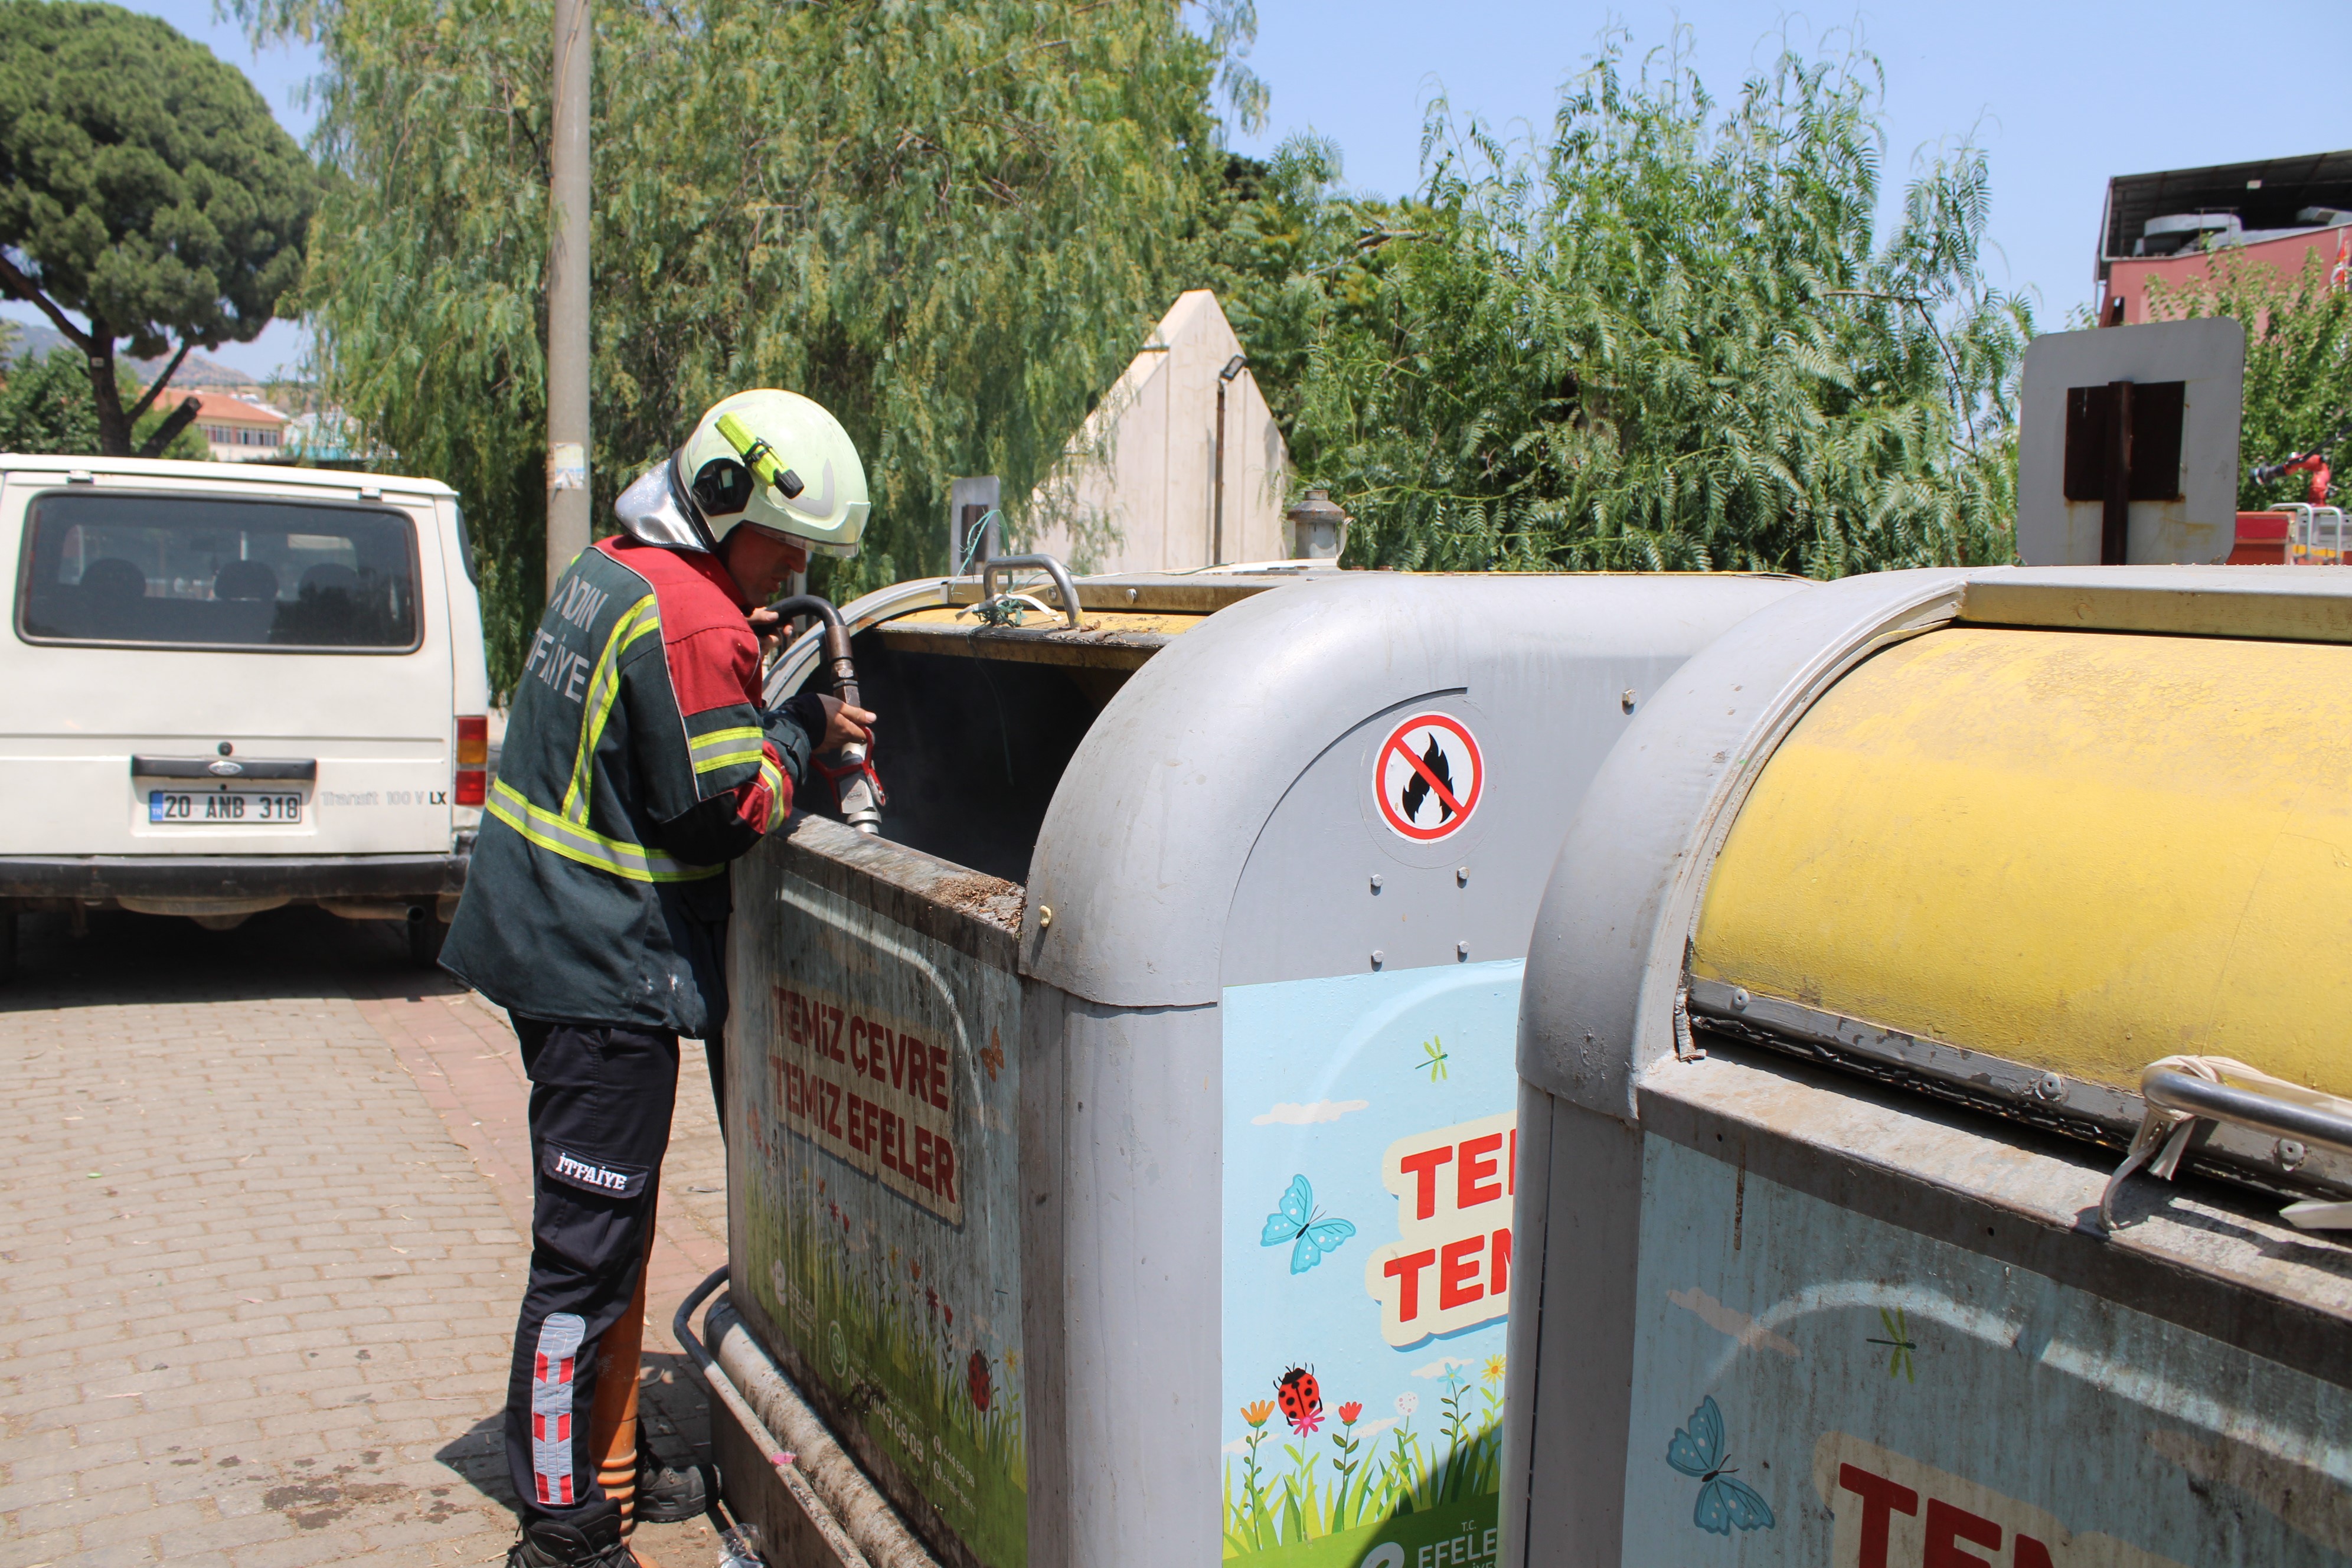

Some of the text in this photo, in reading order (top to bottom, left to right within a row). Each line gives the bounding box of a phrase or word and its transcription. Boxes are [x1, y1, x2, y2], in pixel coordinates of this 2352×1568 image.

[165, 795, 298, 819] 20 ANB 318
[321, 790, 447, 806] Transit 100 V LX
[772, 985, 948, 1112] TEMİZ ÇEVRE
[769, 1055, 956, 1204] TEMİZ EFELER
[556, 1152, 628, 1190] İTFAİYE
[1400, 1128, 1517, 1220] TE
[1461, 1520, 1477, 1532] T.C.
